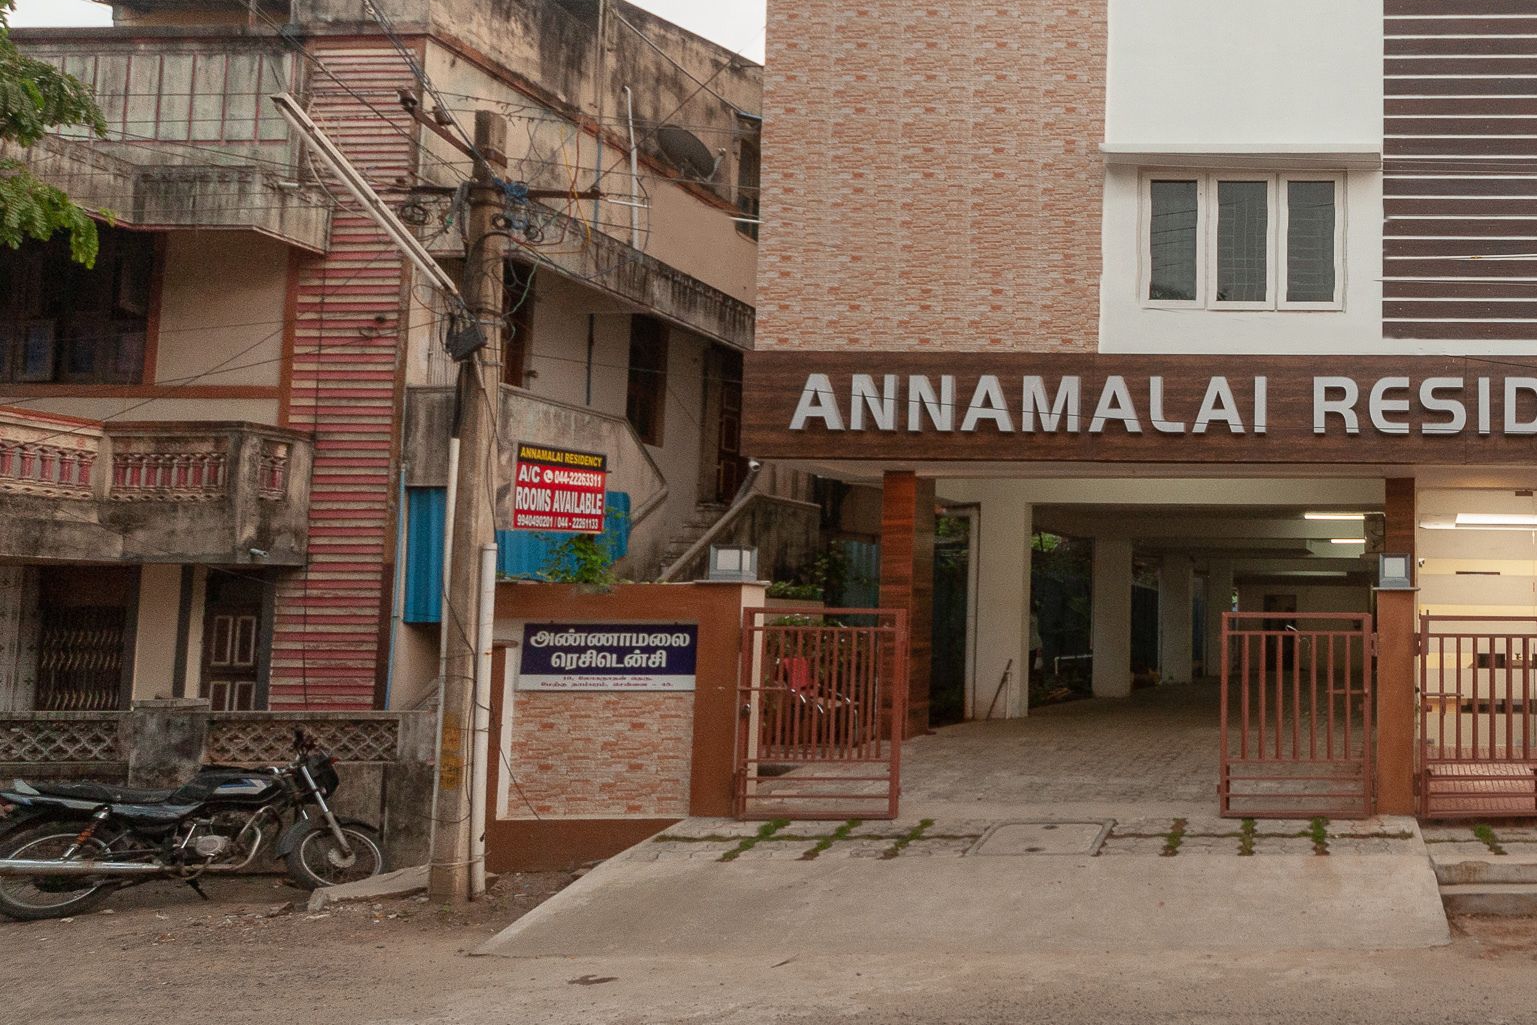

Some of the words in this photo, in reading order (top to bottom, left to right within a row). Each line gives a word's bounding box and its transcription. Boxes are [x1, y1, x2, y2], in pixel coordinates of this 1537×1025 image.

[788, 373, 1268, 434] ANNAMALAI
[520, 446, 563, 463] ANNAMALAI
[564, 452, 603, 467] RESIDENCY
[518, 464, 541, 483] A/C
[515, 486, 552, 512] ROOMS
[552, 490, 603, 515] AVAILABLE
[530, 628, 691, 648] அண்ணாமலை
[551, 649, 667, 670] ரெசிடென்சி
